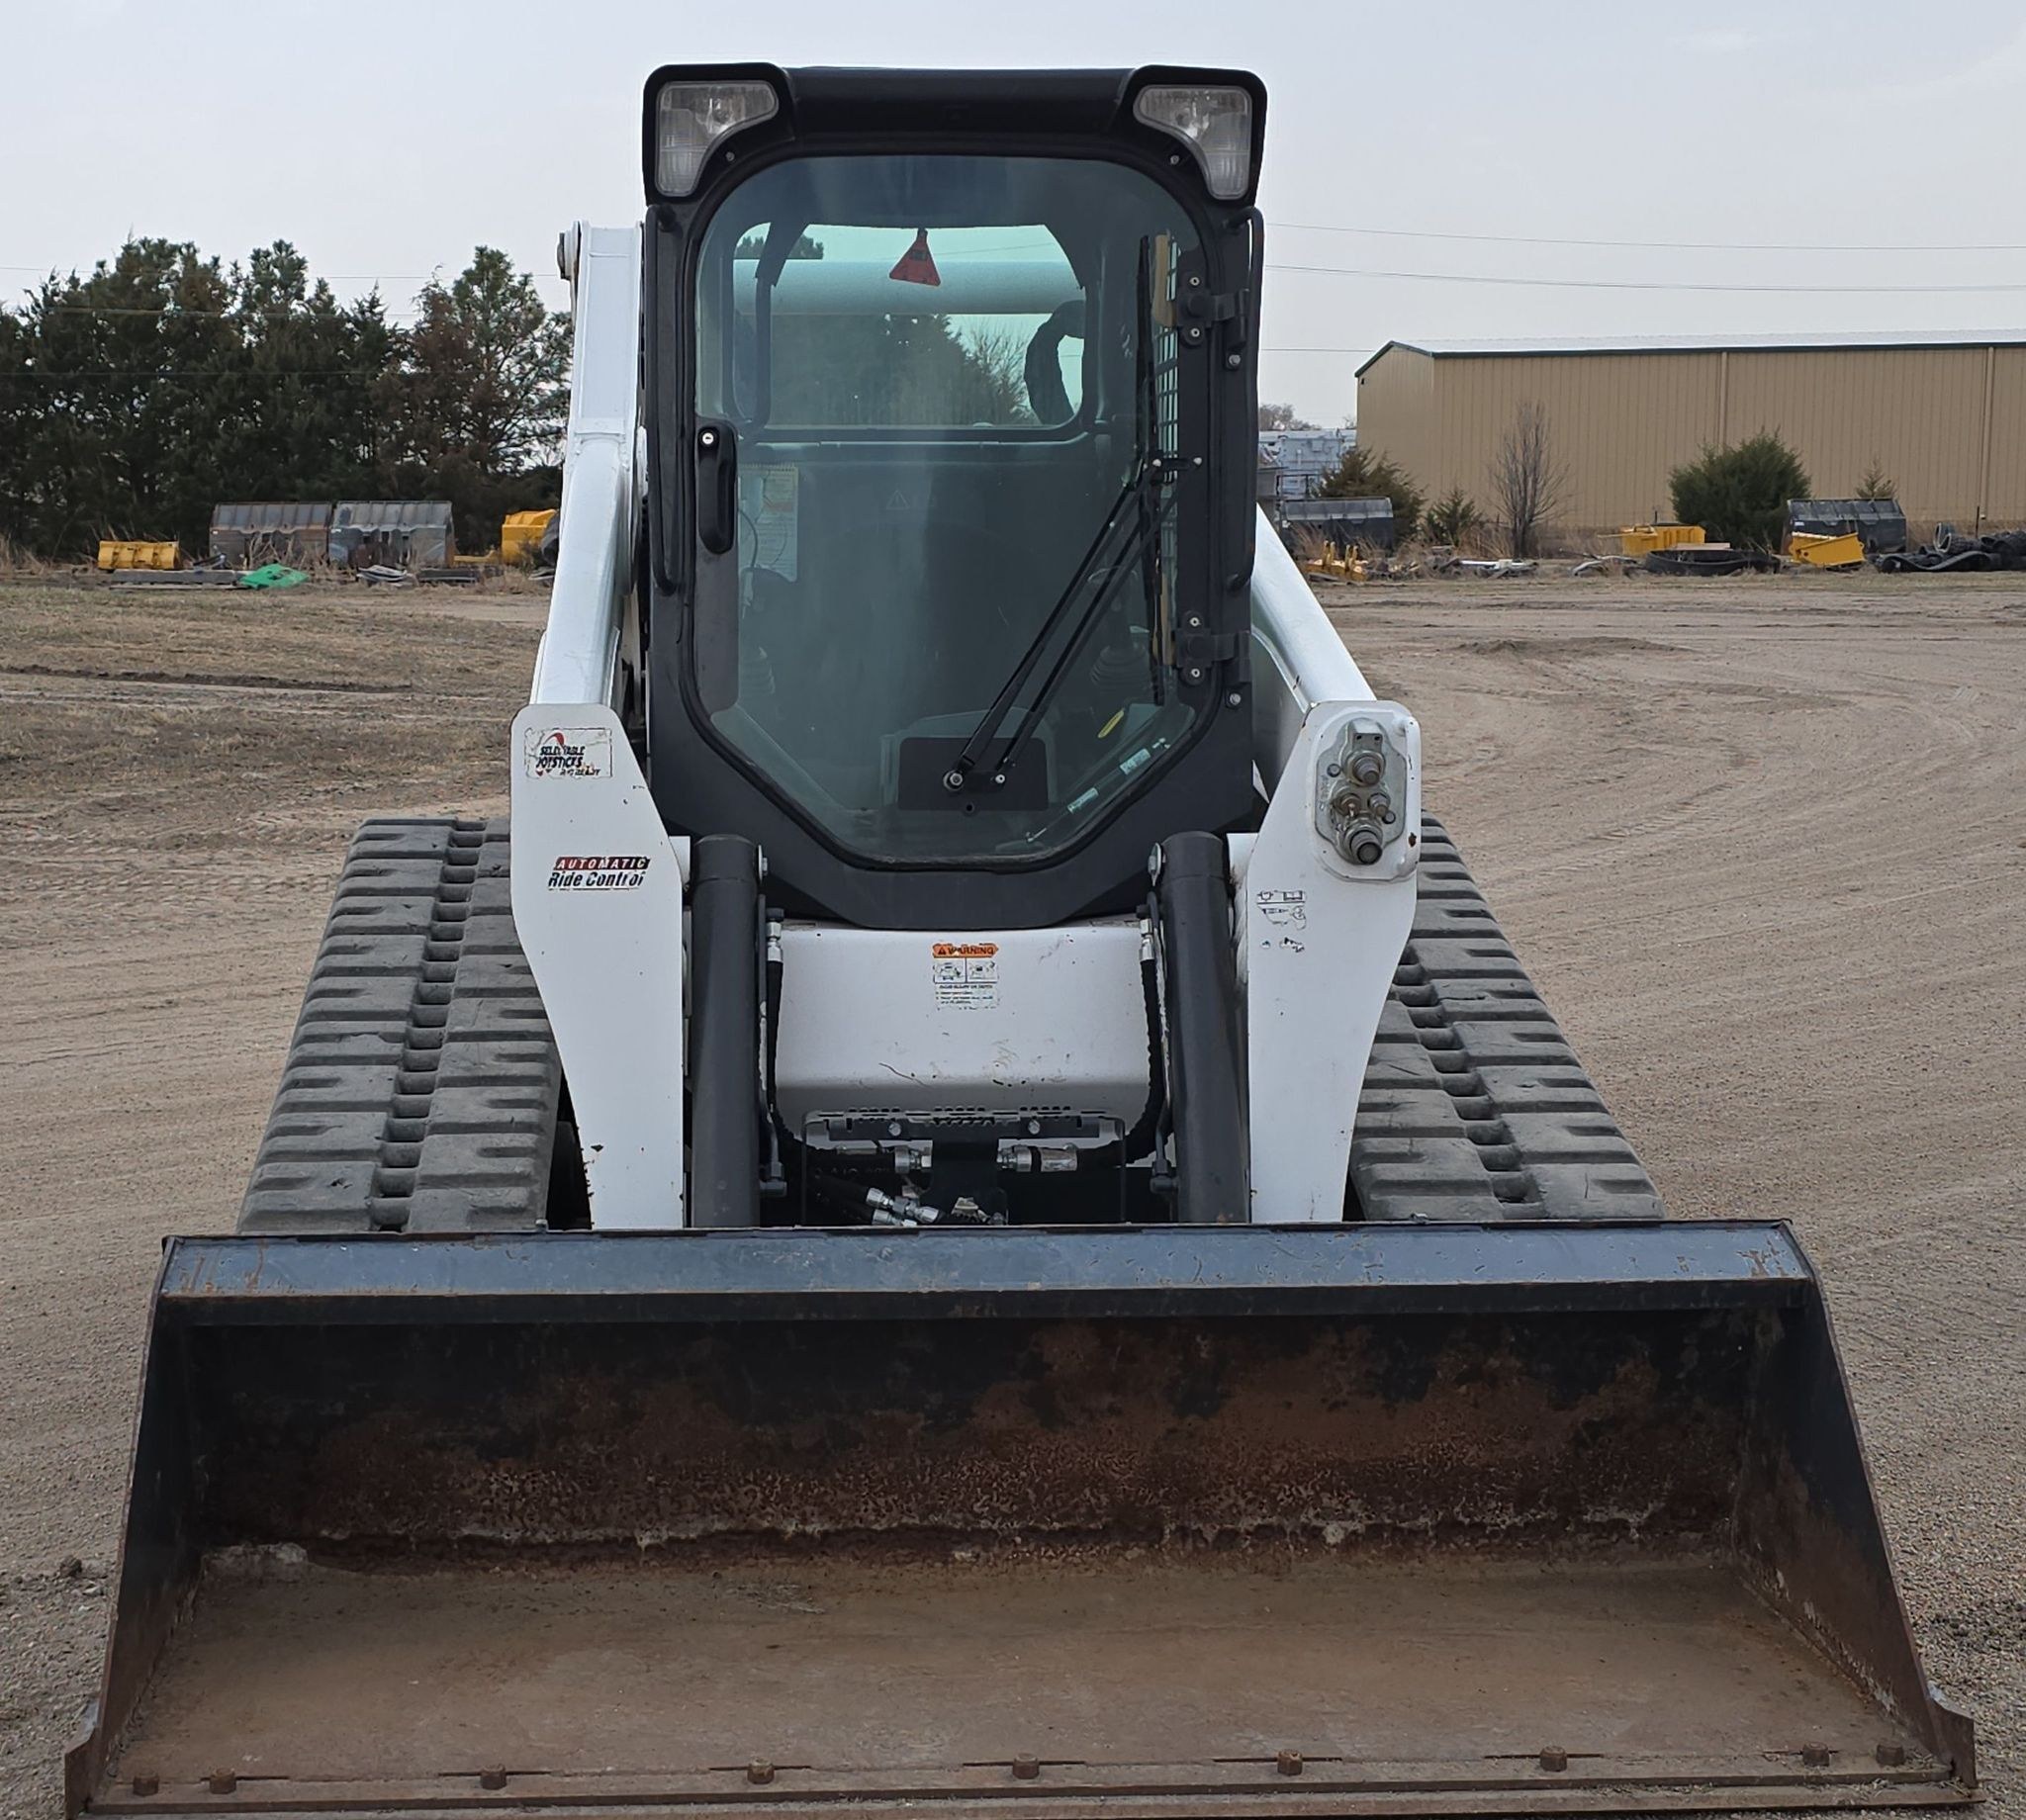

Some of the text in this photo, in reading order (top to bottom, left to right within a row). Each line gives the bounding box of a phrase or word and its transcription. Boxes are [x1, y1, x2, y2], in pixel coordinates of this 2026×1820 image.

[556, 858, 647, 869] AUTOMATIC
[548, 871, 646, 887] Ride Control
